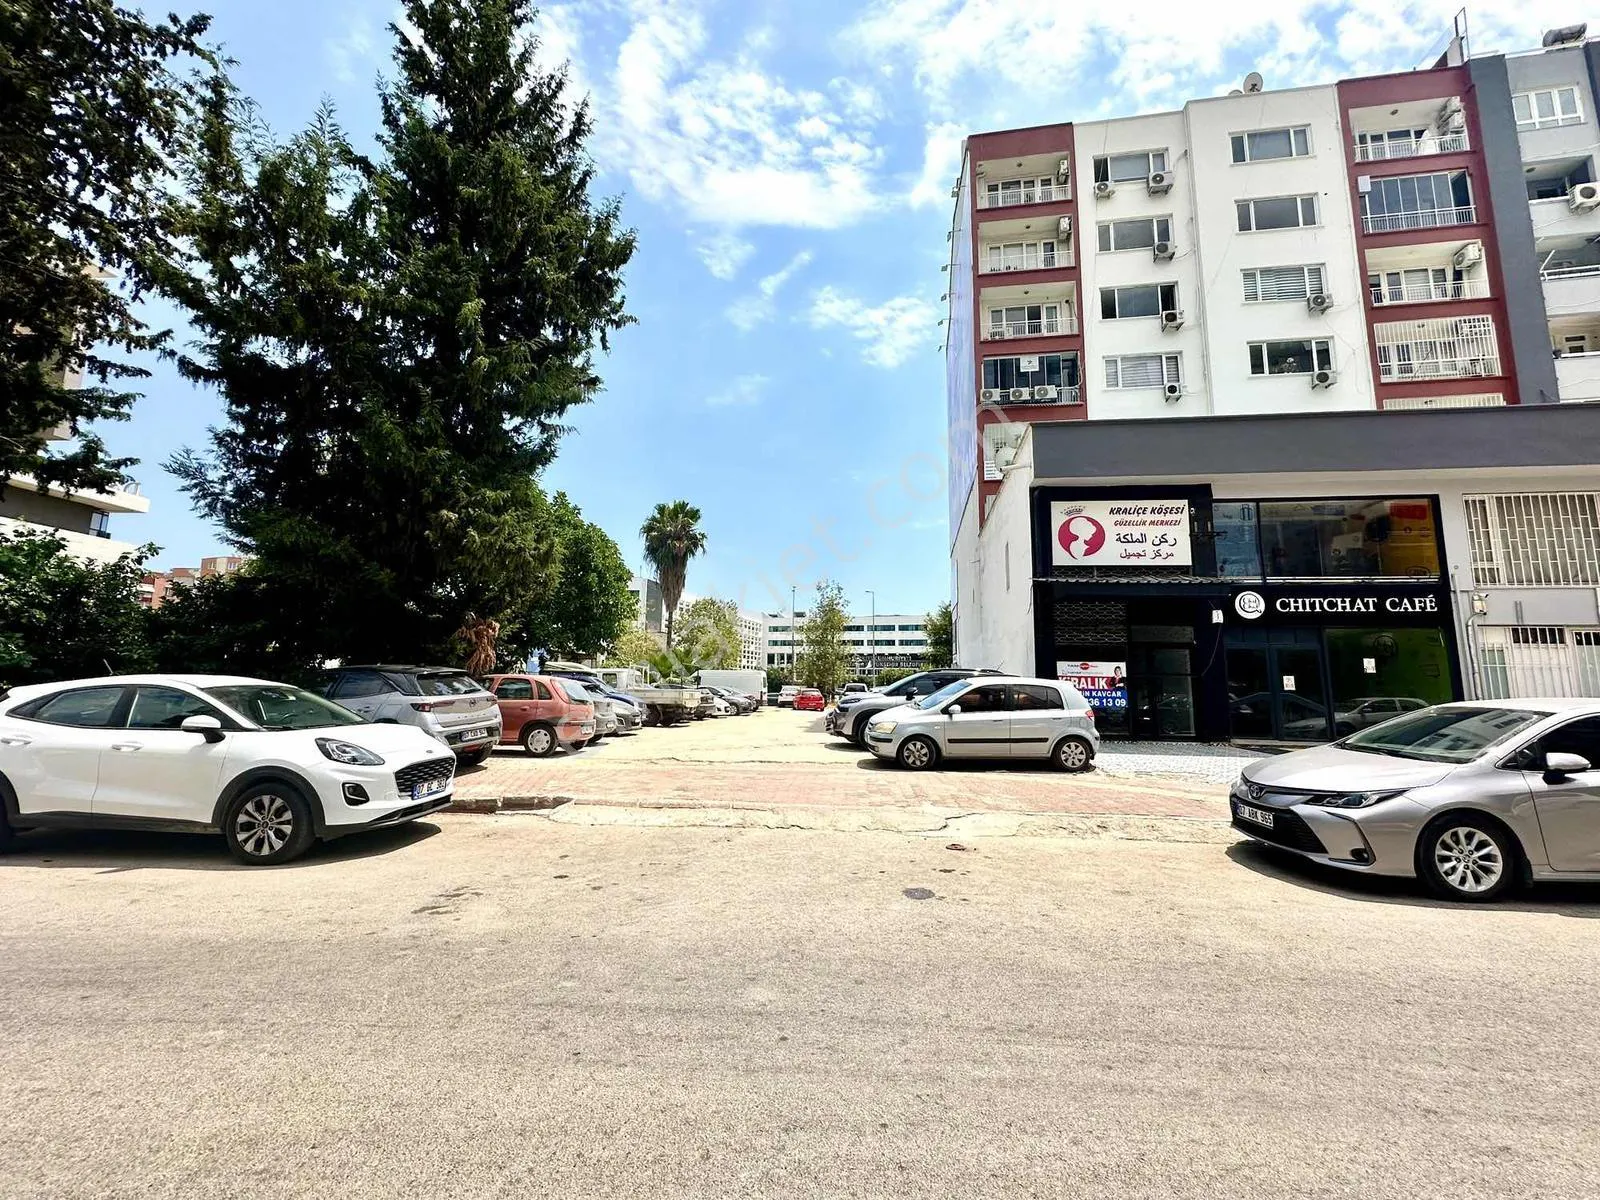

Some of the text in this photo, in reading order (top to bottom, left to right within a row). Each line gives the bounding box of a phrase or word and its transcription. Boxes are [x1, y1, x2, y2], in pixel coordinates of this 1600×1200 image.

[1109, 504, 1186, 517] KRALİÇE KÖŞESİ
[1114, 518, 1182, 527] GÜZELLİK MERKEZİ
[1115, 532, 1177, 547] ركن الملكة
[1120, 548, 1174, 560] مركز تجميل
[1275, 597, 1377, 612] CHITCHAT
[1385, 595, 1438, 612] CAFÉ
[1058, 676, 1109, 690] RALIK
[1102, 698, 1113, 707] 13
[1115, 698, 1126, 707] 09
